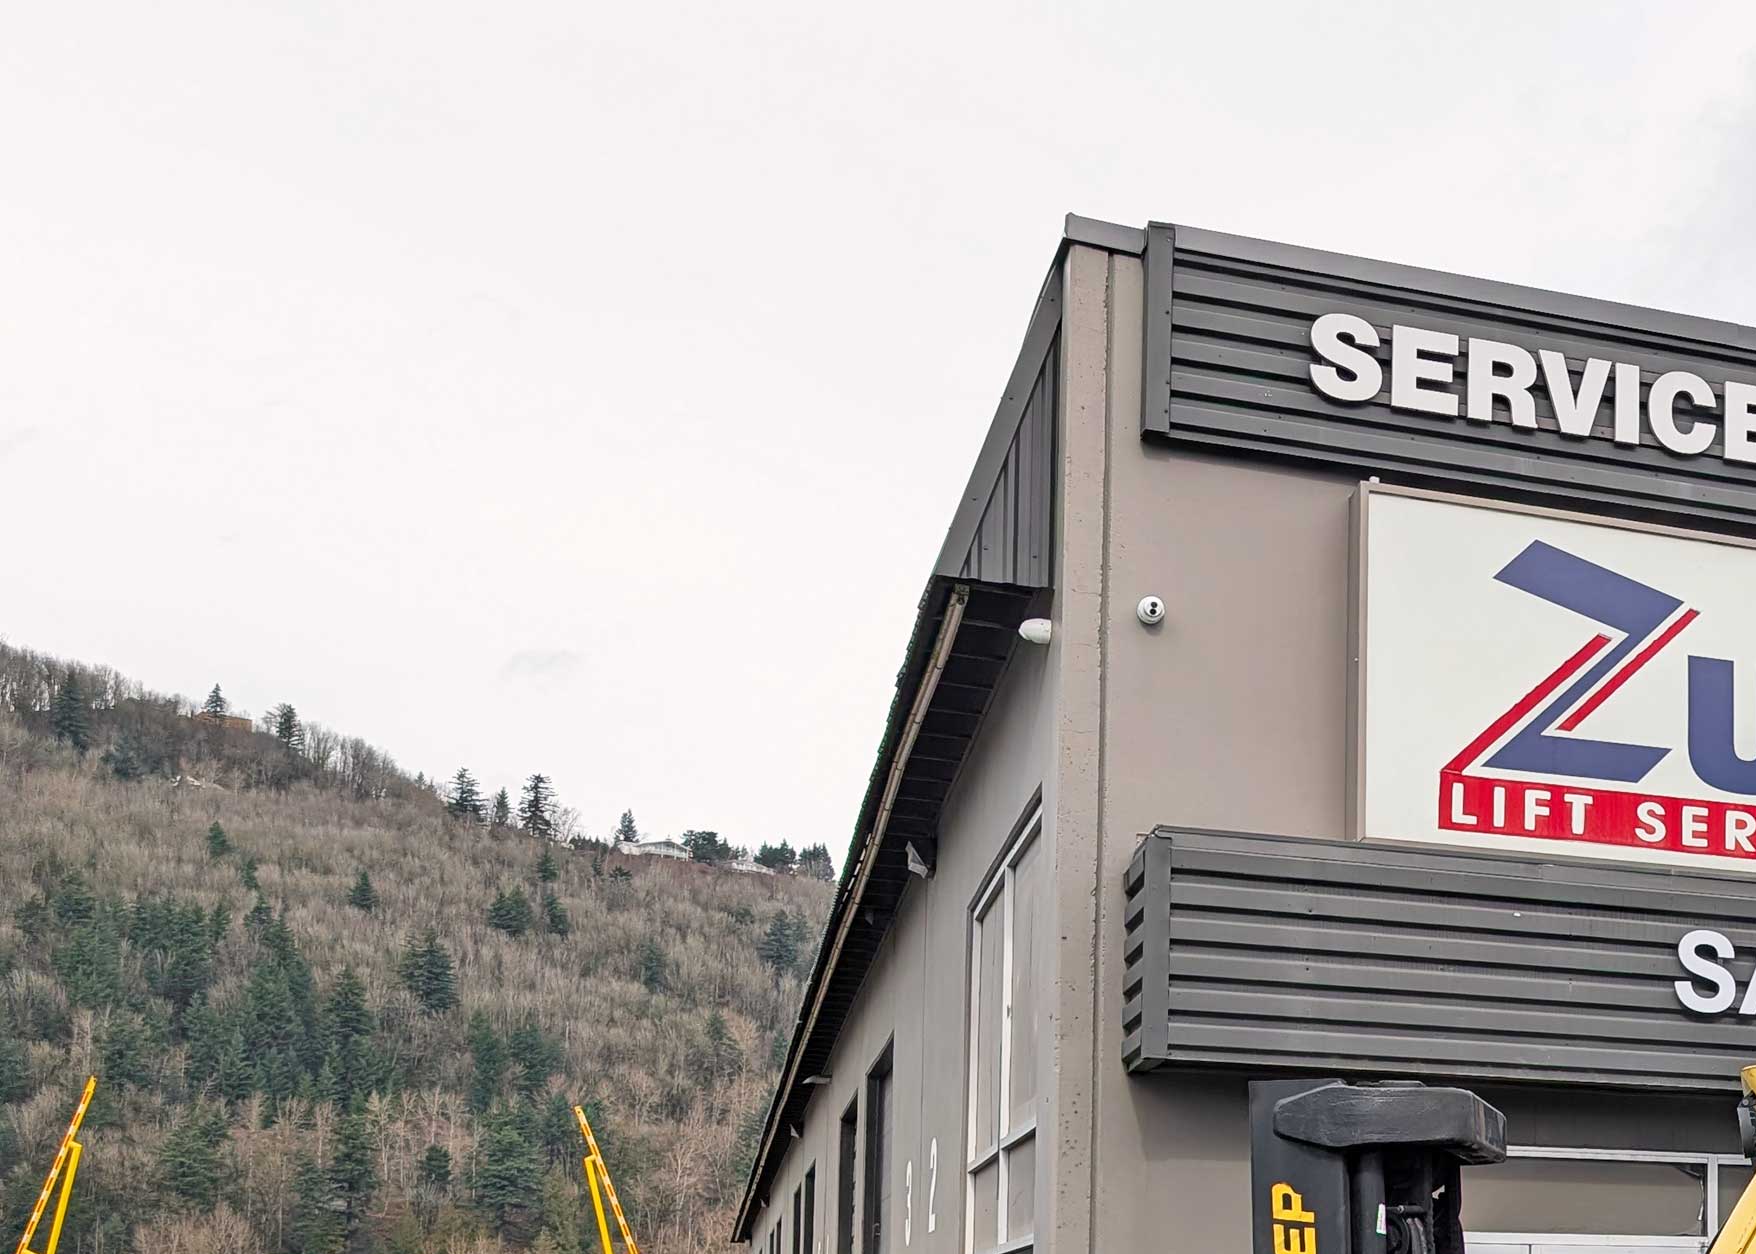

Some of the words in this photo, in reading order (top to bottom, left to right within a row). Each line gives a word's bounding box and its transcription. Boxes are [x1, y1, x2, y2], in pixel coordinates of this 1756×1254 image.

[1451, 782, 1594, 835] LIFT
[905, 1160, 912, 1247] 3
[928, 1137, 937, 1233] 2
